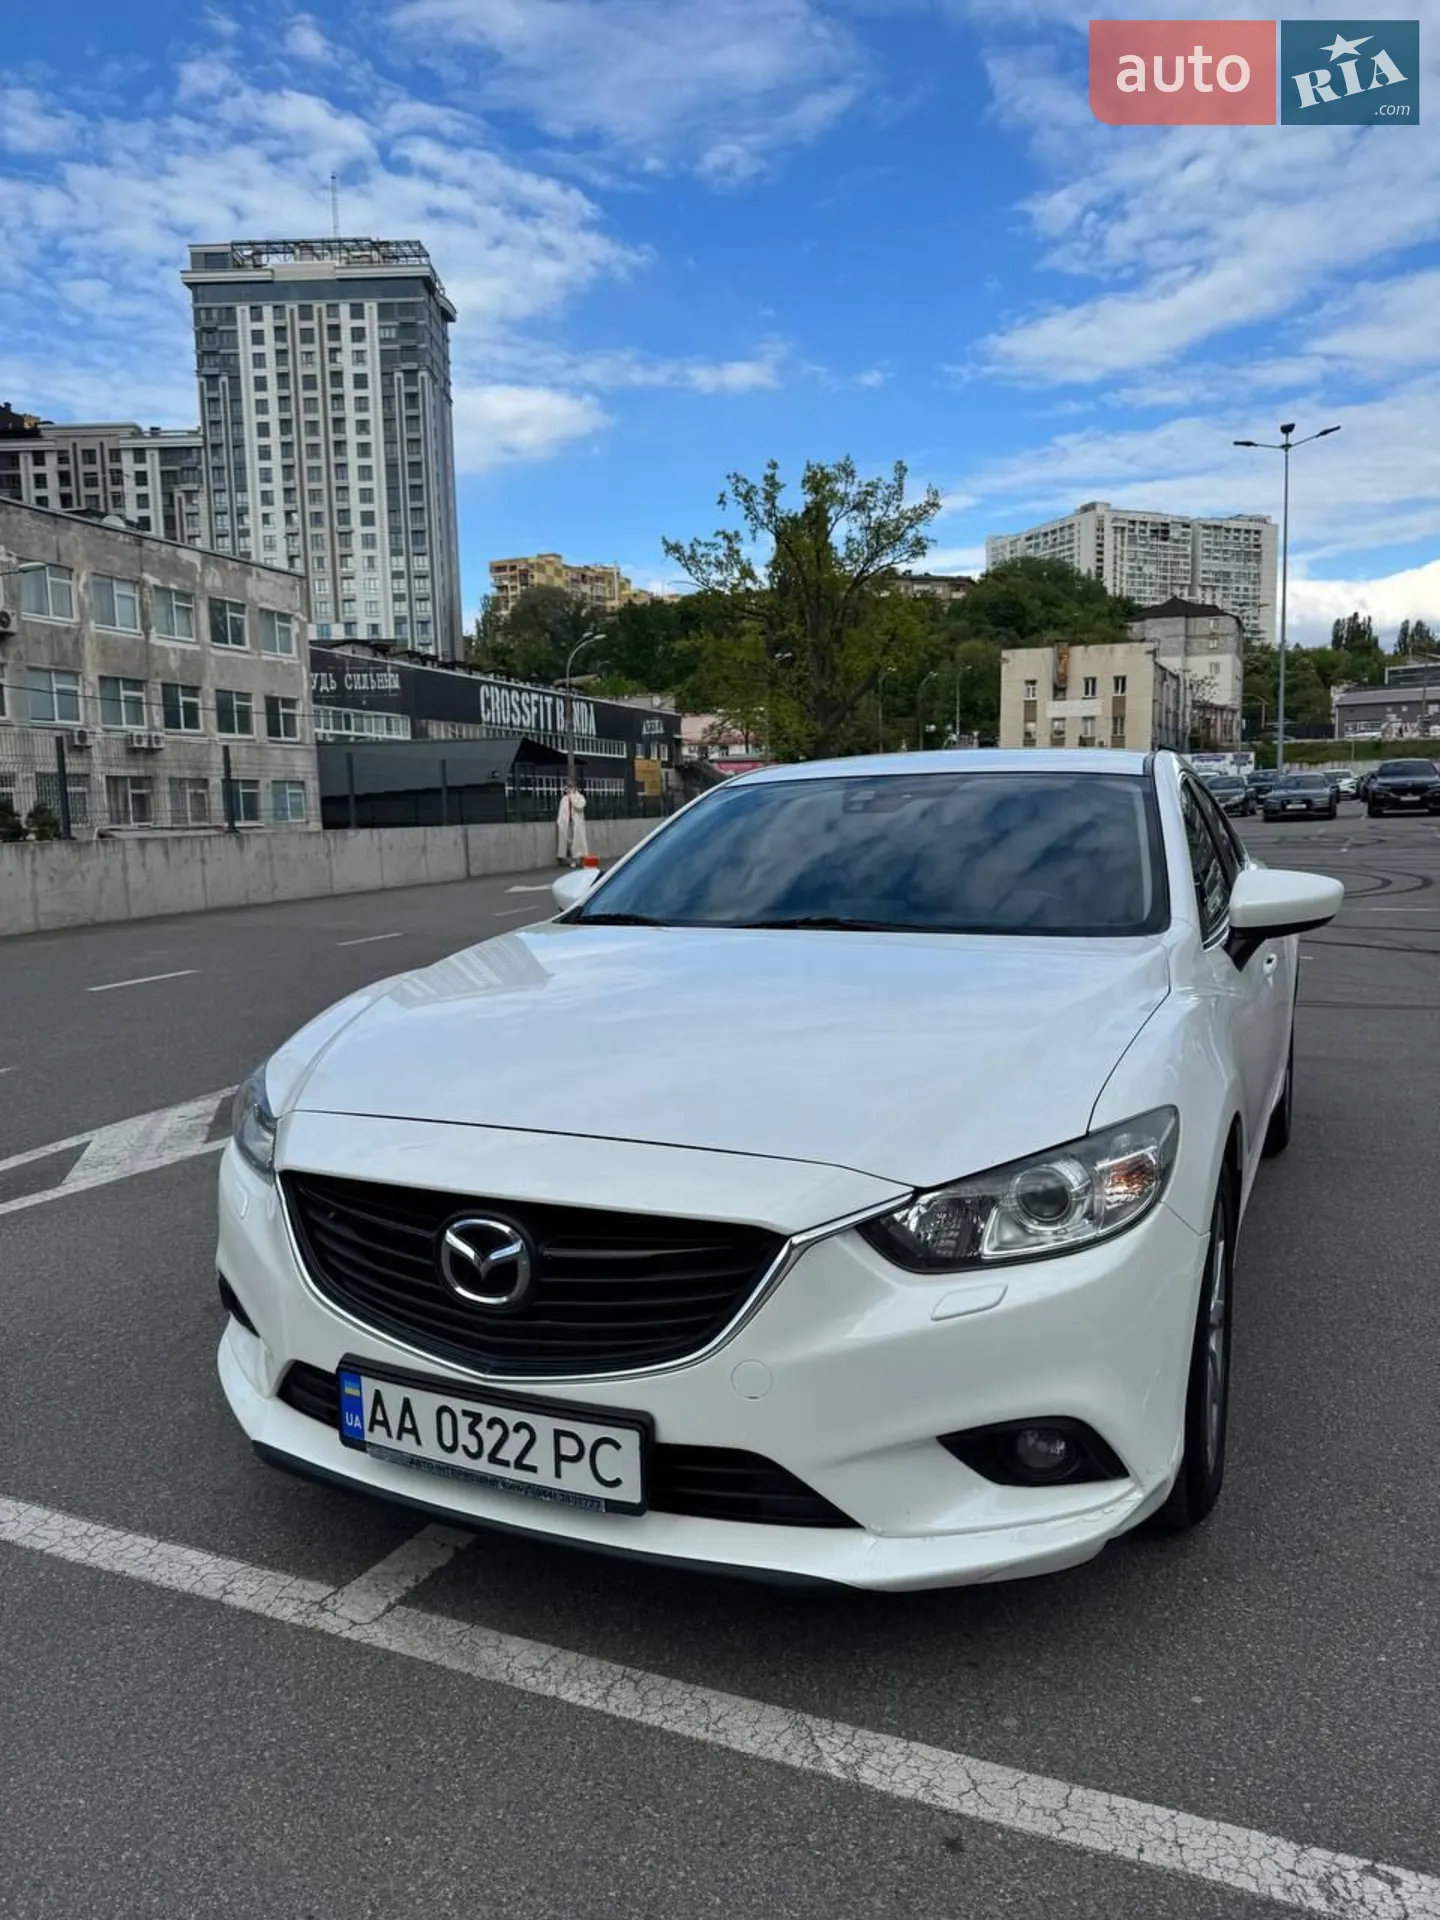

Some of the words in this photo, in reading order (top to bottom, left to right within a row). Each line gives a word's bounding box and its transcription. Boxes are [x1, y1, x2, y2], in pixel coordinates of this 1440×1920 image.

[310, 672, 337, 693] УДЬ
[480, 684, 553, 734] CROSSFIT
[555, 696, 597, 737] BNDA
[345, 1411, 363, 1429] UA
[368, 1388, 422, 1447] AA
[435, 1404, 538, 1474] 0322
[553, 1427, 623, 1489] PC
